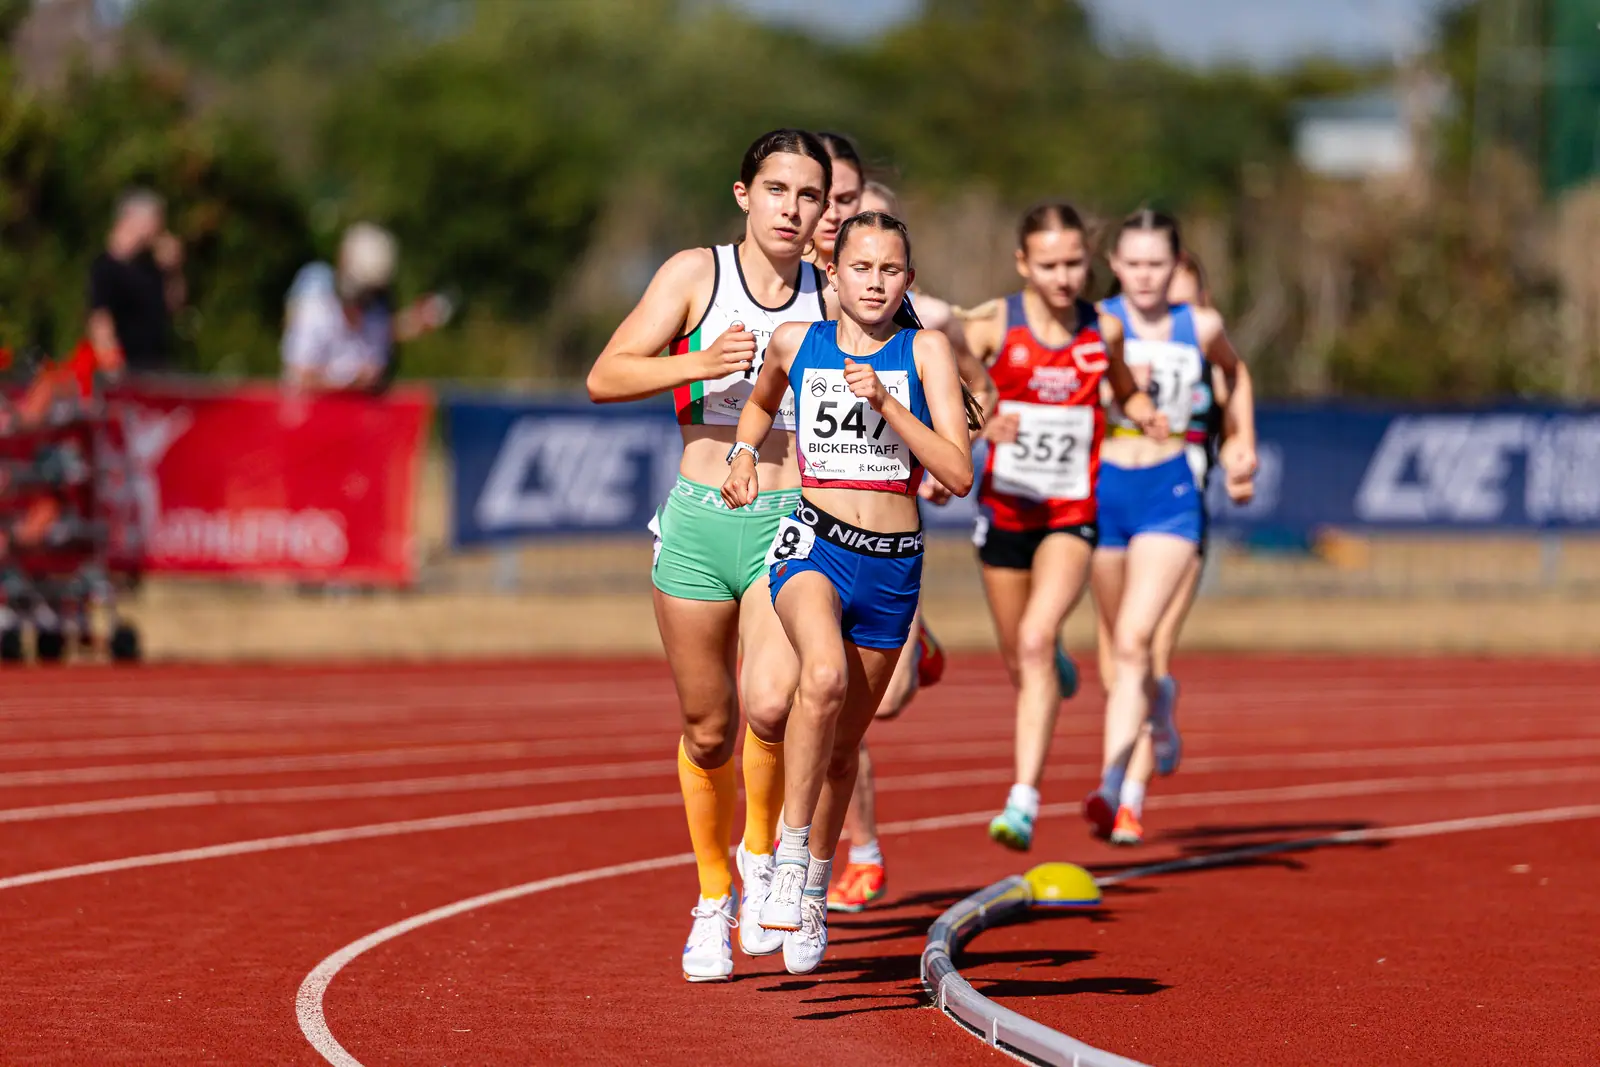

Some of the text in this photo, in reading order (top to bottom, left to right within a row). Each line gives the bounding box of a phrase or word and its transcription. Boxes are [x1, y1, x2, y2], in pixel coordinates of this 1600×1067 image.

[808, 442, 899, 455] BICKERSTAFF
[1012, 432, 1076, 464] 552
[867, 464, 900, 472] KUKRI
[773, 526, 801, 560] 8
[827, 523, 895, 552] NIKE
[897, 533, 924, 553] PR
